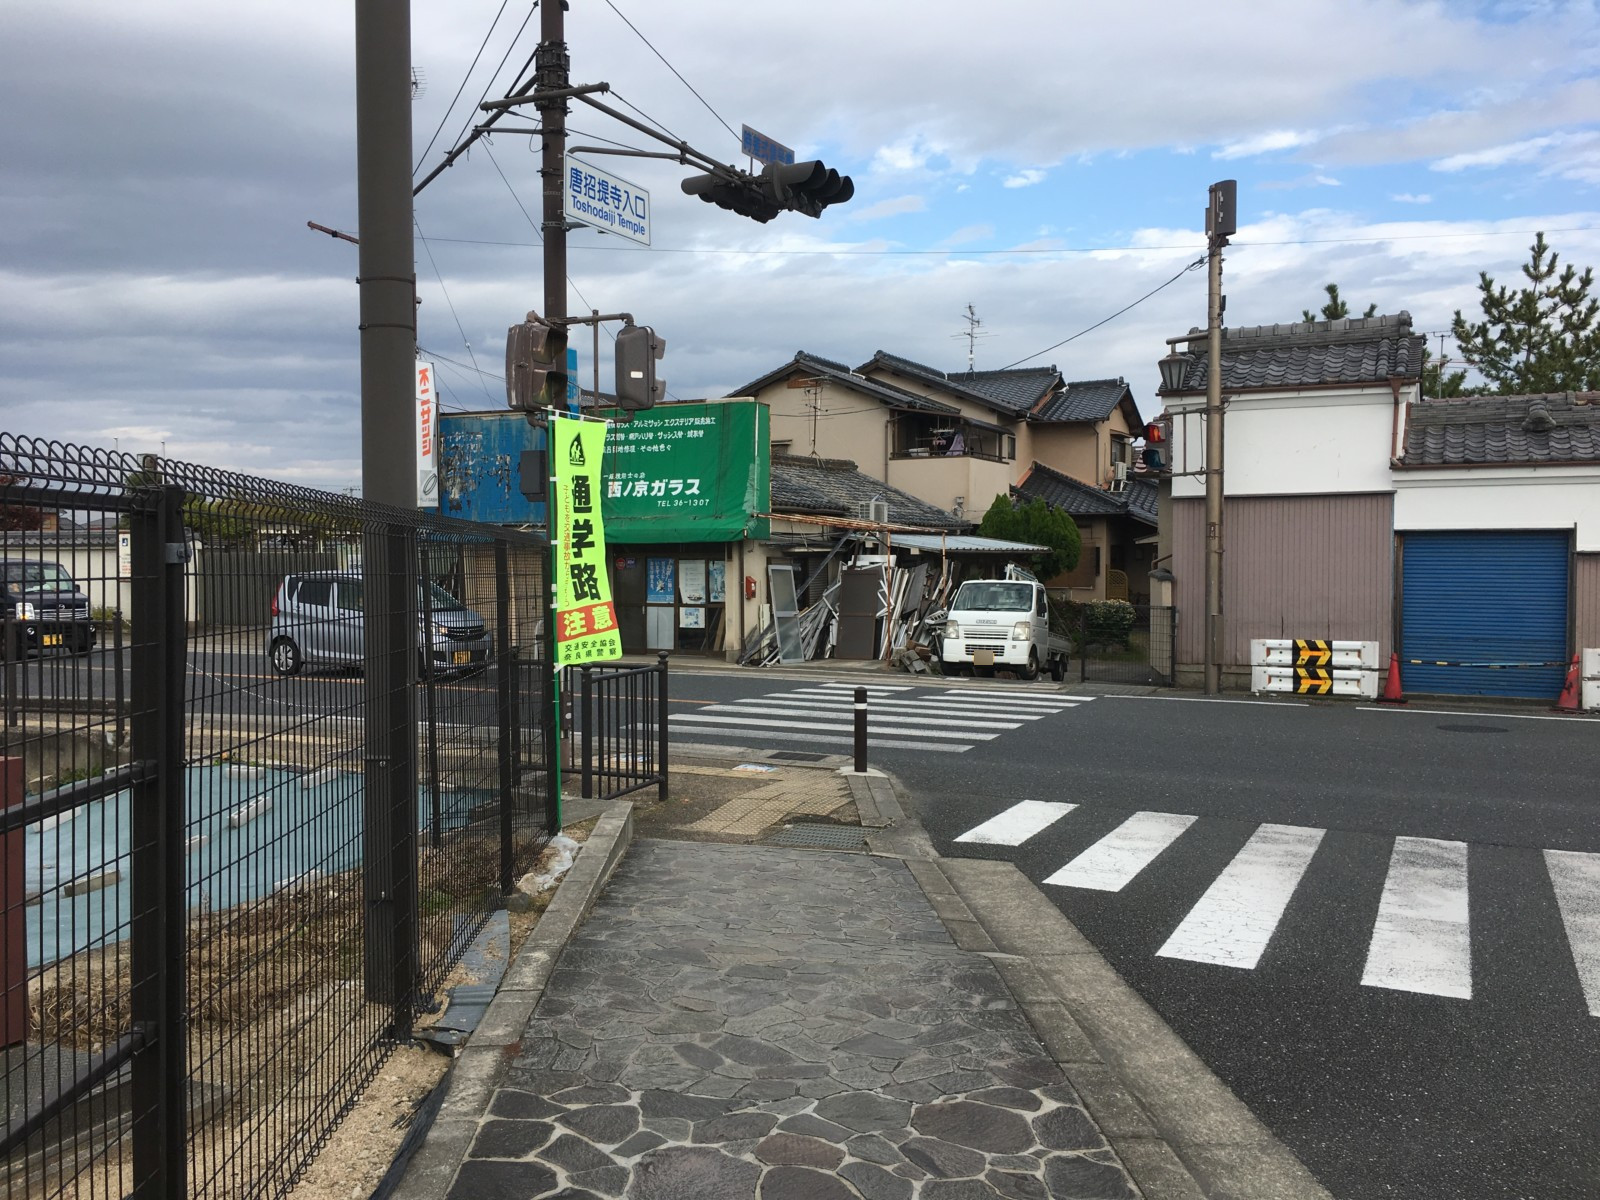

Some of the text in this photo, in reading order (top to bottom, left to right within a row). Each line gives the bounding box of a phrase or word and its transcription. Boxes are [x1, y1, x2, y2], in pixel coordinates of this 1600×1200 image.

[569, 166, 646, 220] 唐招提寺入口
[571, 194, 645, 236] Toshodaiji Temple
[607, 478, 701, 498] 西ノ京ガラス
[673, 499, 710, 507] 36-1307
[570, 474, 602, 602] 通学路
[563, 604, 613, 637] 注意
[564, 647, 617, 661] 奈良県警察
[565, 638, 616, 653] 交通安全協会
